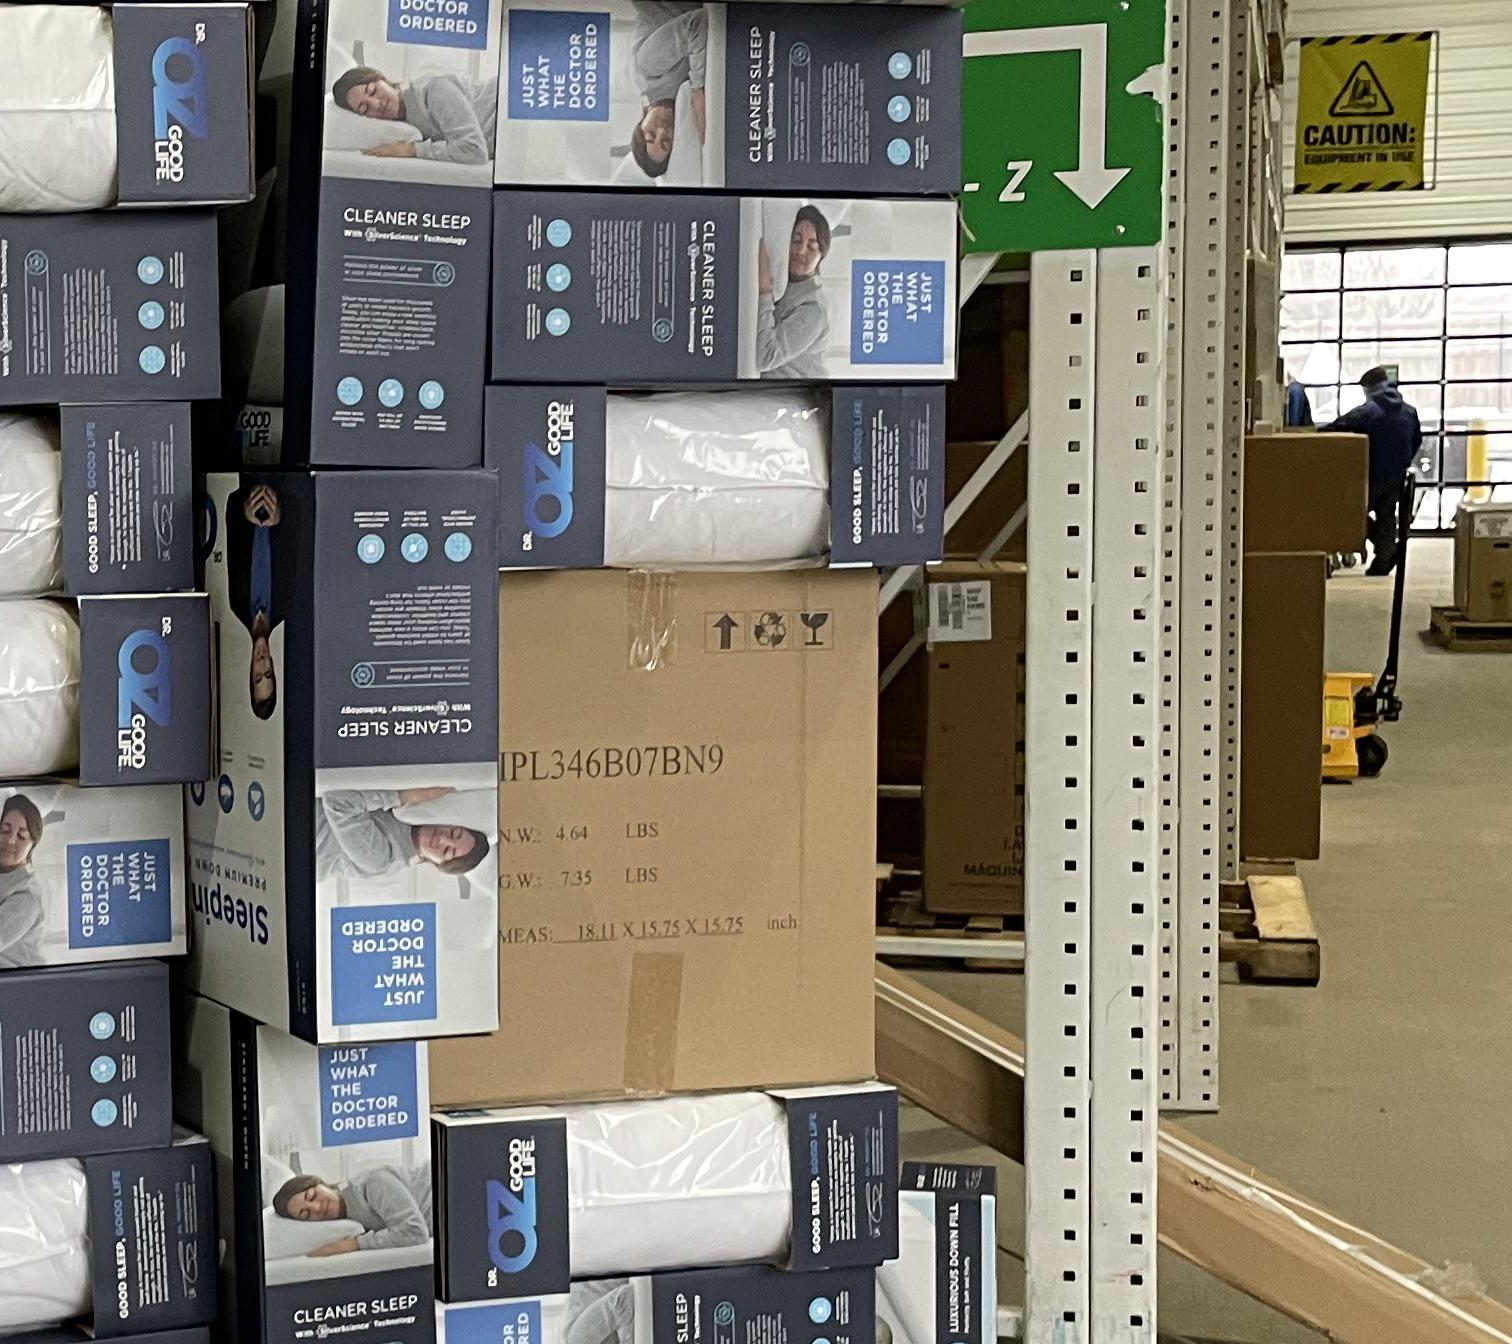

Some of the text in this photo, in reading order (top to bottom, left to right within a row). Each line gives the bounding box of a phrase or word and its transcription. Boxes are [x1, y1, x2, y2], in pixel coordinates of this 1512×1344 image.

[399, 14, 478, 34] ORDERED
[1304, 123, 1415, 146] CAUTION:
[998, 160, 1033, 202] Z
[343, 207, 471, 230] CLEANER SLEEP
[240, 410, 271, 429] GOOD
[117, 629, 172, 728] OZ
[337, 718, 472, 738] CLEANER SLEEP
[117, 729, 132, 768] LIFE
[131, 713, 146, 769] GOOD
[626, 822, 659, 838] LBS
[626, 867, 658, 883] LBS
[341, 918, 424, 936] ORDERED
[766, 913, 798, 931] inch
[352, 936, 424, 954] DOCTOR
[391, 954, 425, 970] THE
[374, 972, 425, 989] WHAT
[383, 990, 425, 1006] JUST
[949, 1228, 960, 1266] DOWN
